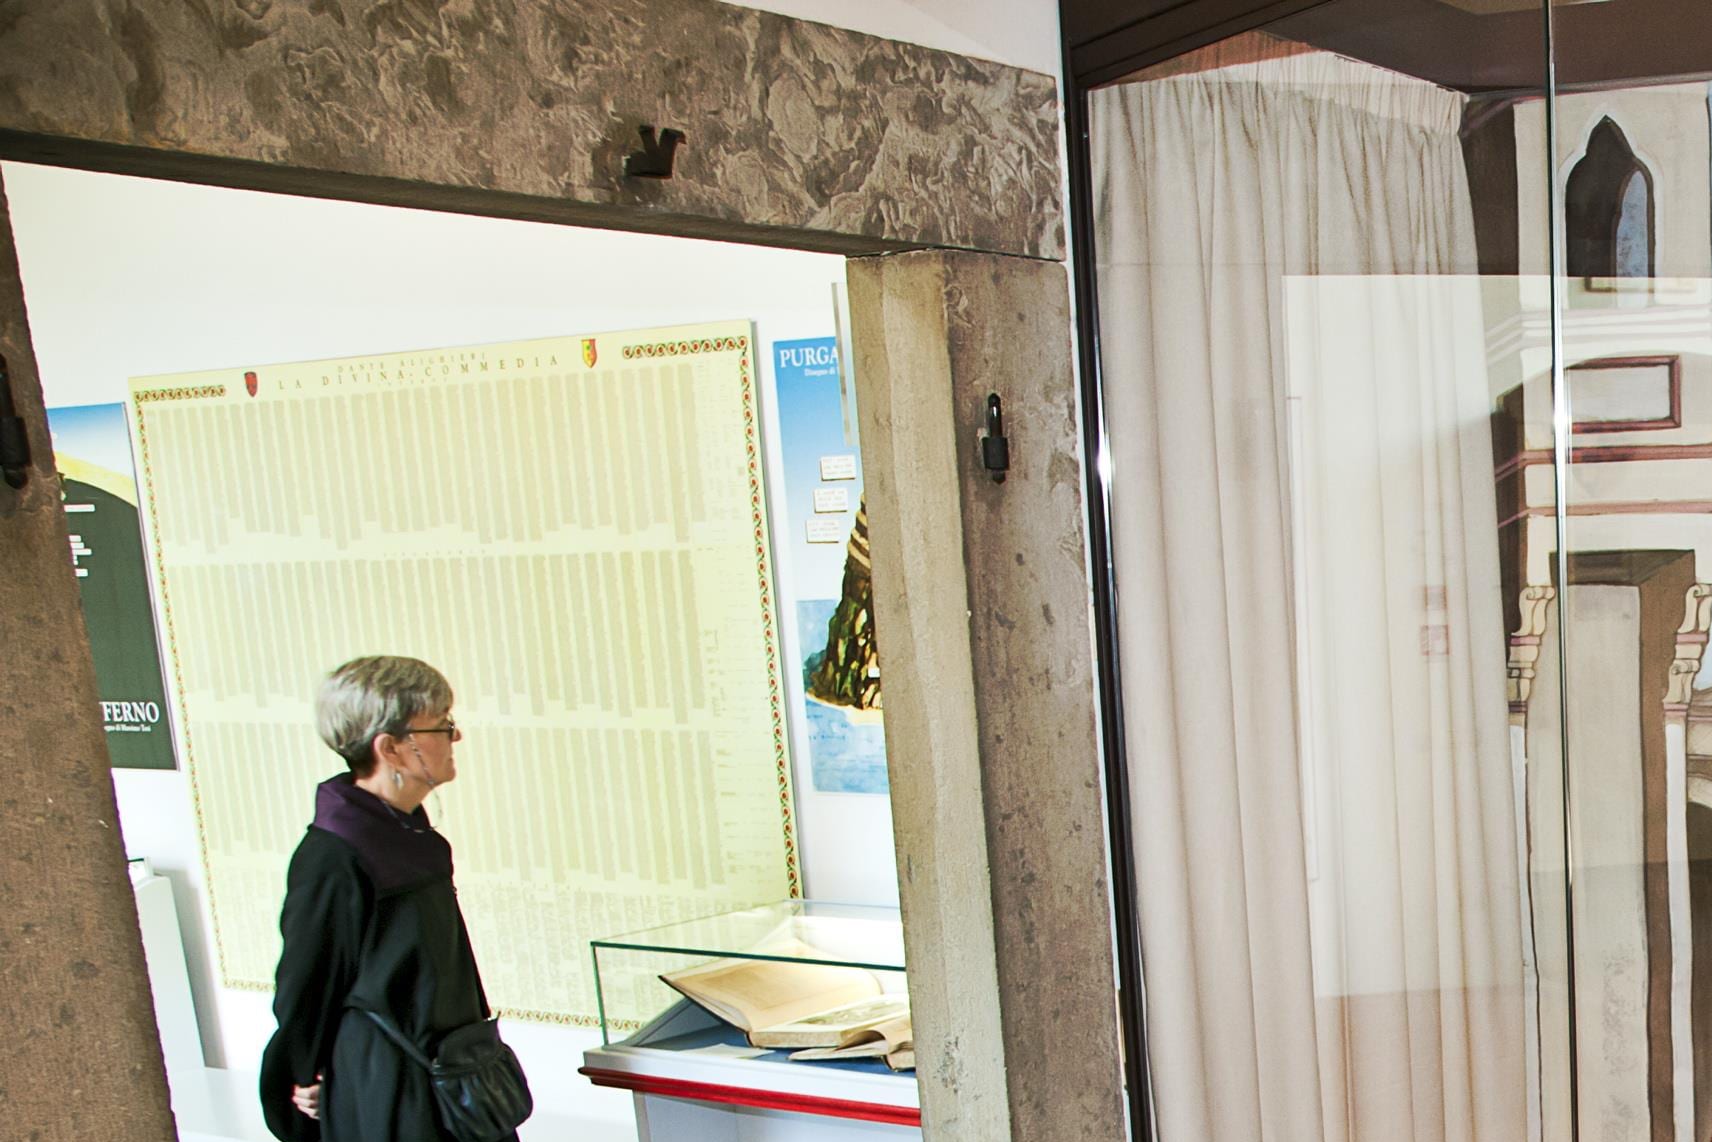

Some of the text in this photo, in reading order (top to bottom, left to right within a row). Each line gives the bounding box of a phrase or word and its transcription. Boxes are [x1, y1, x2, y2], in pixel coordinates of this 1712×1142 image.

[779, 346, 838, 368] PURGA
[322, 369, 405, 386] DIVINA
[424, 355, 558, 377] COMMEDIA
[99, 701, 159, 723] FERNO
